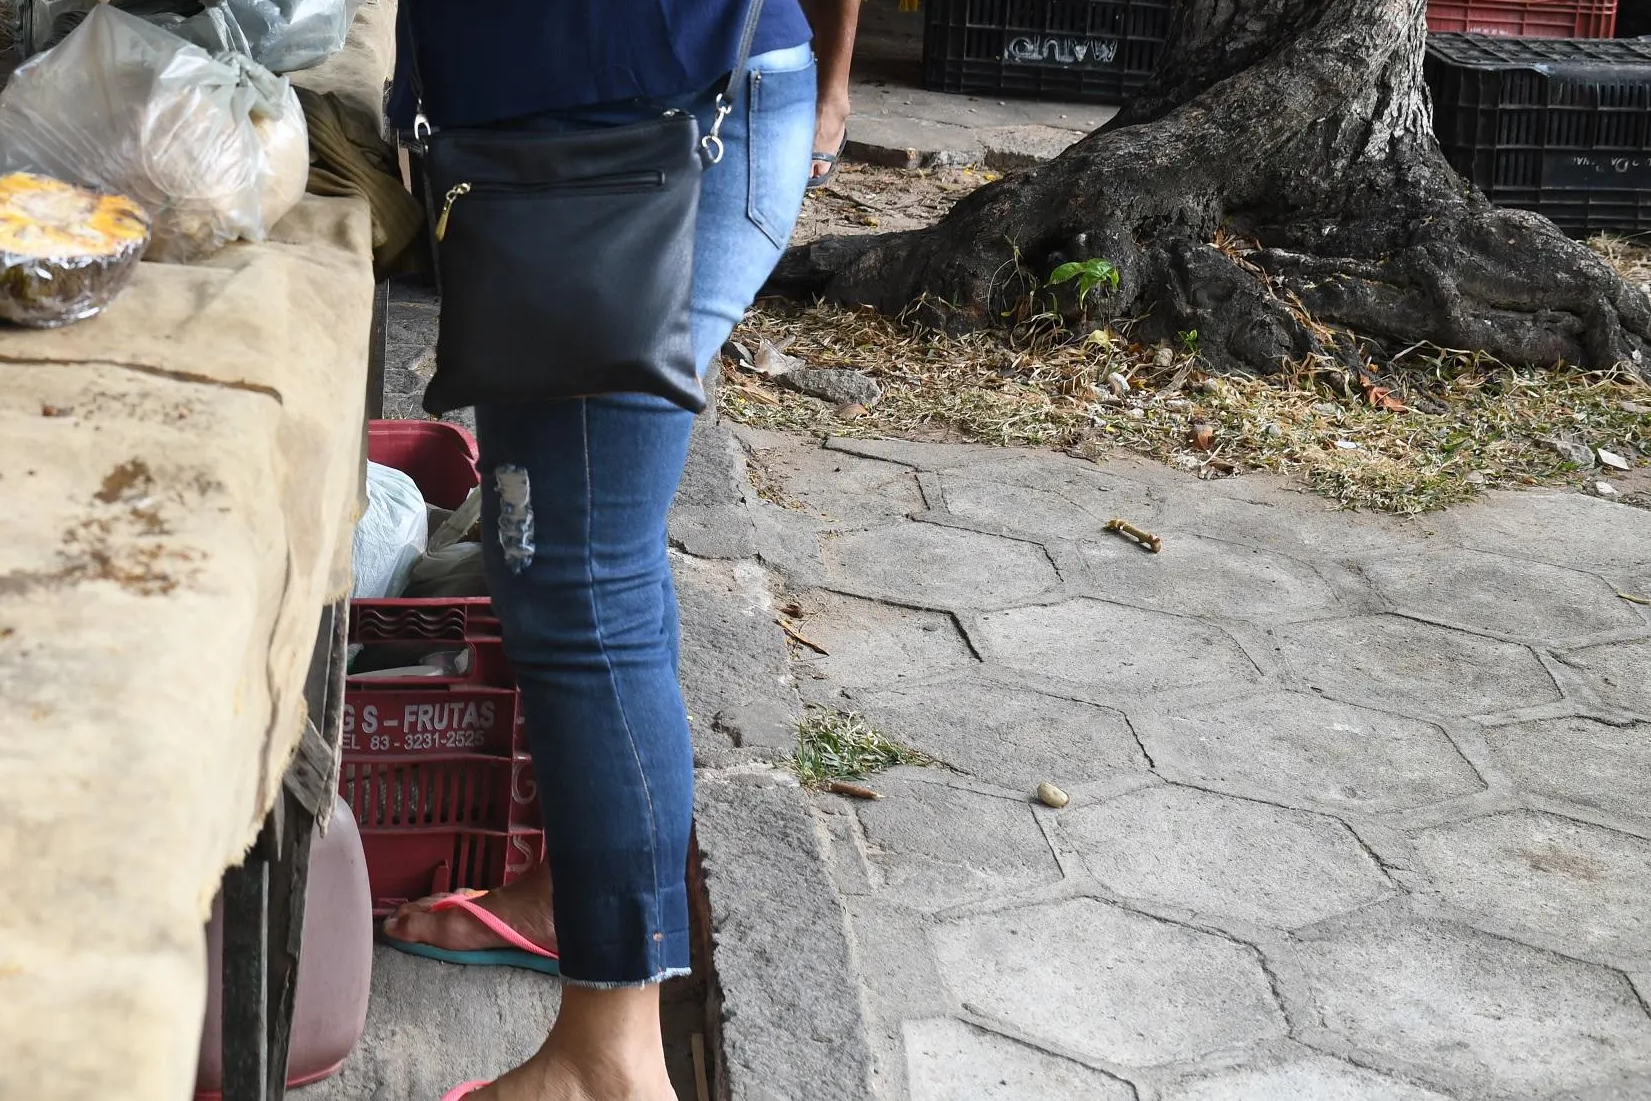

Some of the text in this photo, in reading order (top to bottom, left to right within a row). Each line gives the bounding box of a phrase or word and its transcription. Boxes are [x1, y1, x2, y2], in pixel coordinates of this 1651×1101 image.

[1008, 36, 1117, 62] MATUTO
[404, 701, 496, 733] FRUTAS
[370, 735, 390, 750] 83
[404, 729, 485, 750] 3231-2525
